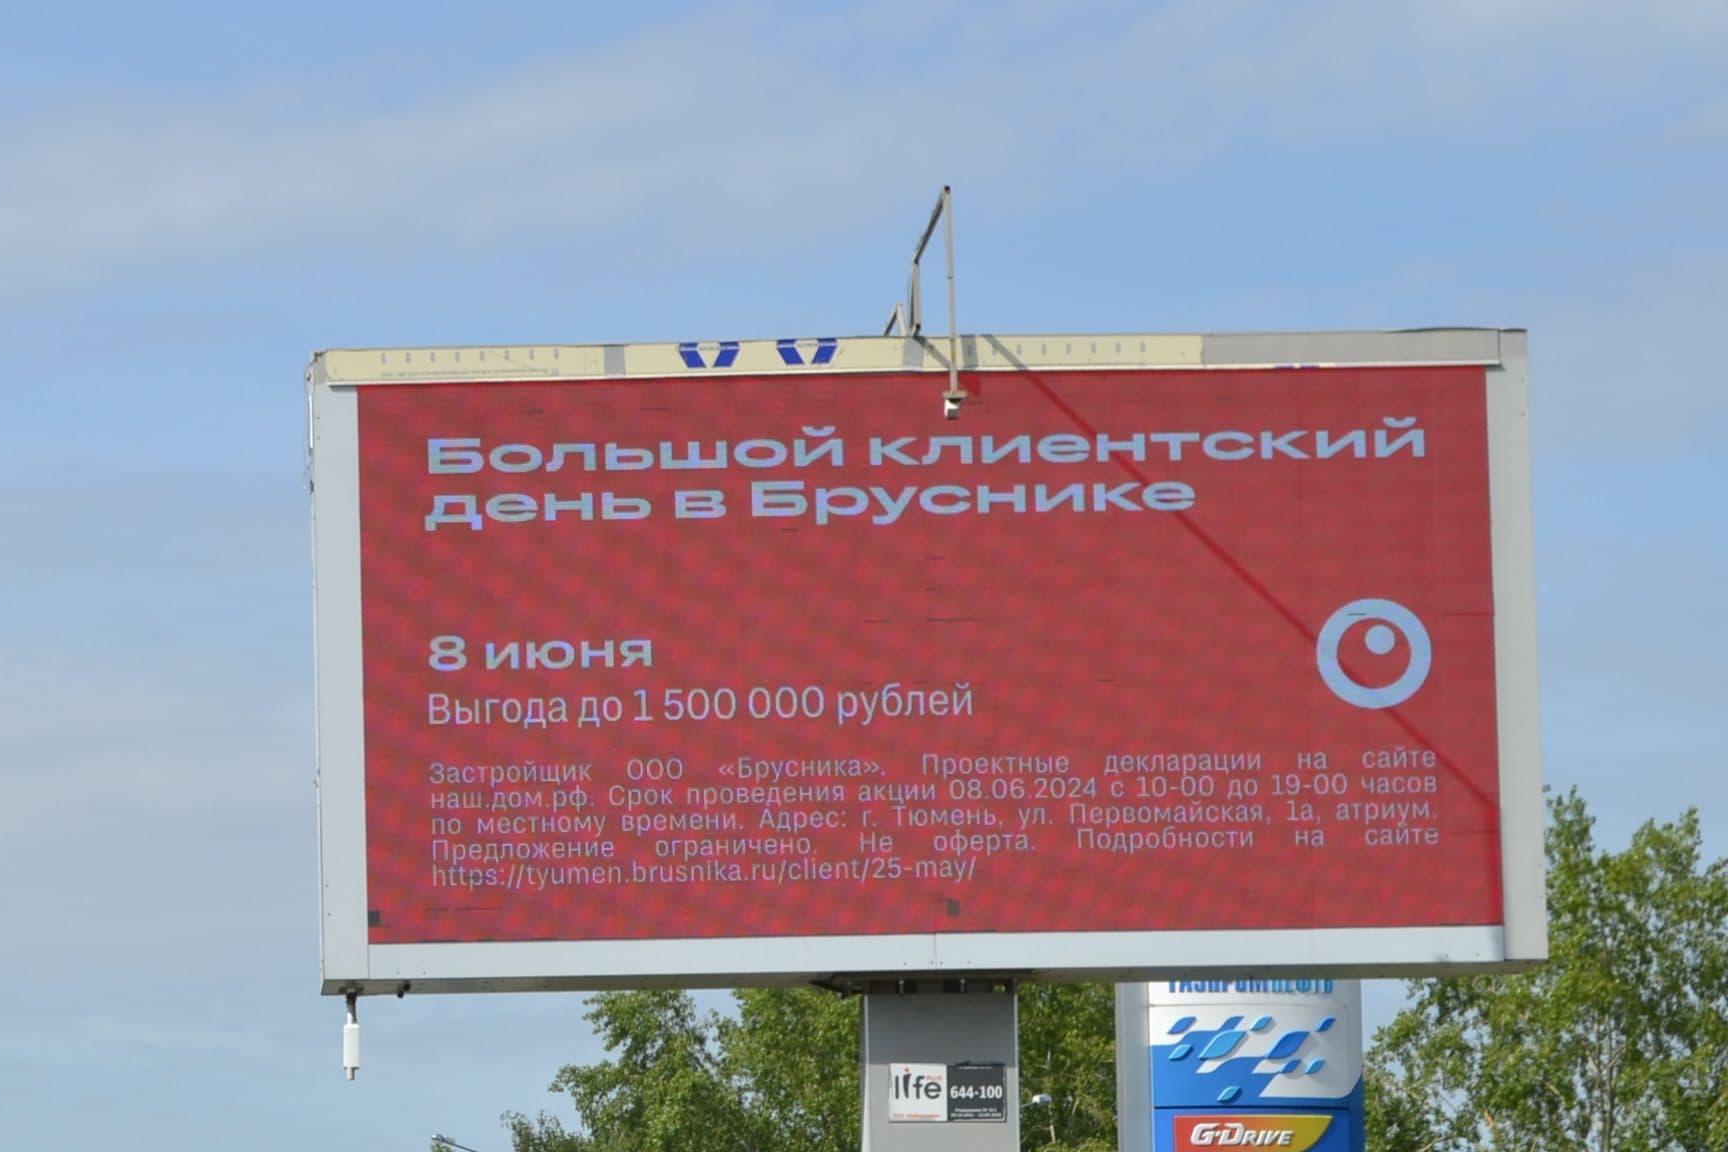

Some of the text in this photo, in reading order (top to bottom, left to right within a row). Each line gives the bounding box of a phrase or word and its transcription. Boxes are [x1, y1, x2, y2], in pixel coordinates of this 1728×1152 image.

[427, 416, 1426, 475] Большой клиентский
[424, 479, 1196, 532] день в Бруснике
[428, 634, 653, 672] 8 июня
[428, 681, 973, 730] Выгода до 1 500 000 рублей
[429, 746, 1436, 788] Застройщик ООО «Брусника». Проектные декларации на сайте
[431, 773, 1437, 813] наш.дом.рф. Срок проведения акции 08.06.2024 с 10-00 до 19-00 часов
[431, 799, 1438, 838] по местному времени. Адрес: г. Тюмень, ул. Первомайская, 1а, атриум.
[432, 823, 1439, 866] Предложение ограничено. Не оферта. Подробности на сайте
[432, 855, 977, 892] https://tyumen.brusnika.ru/client/25-may/
[895, 1067, 942, 1099] life
[950, 1085, 1003, 1099] 644-100
